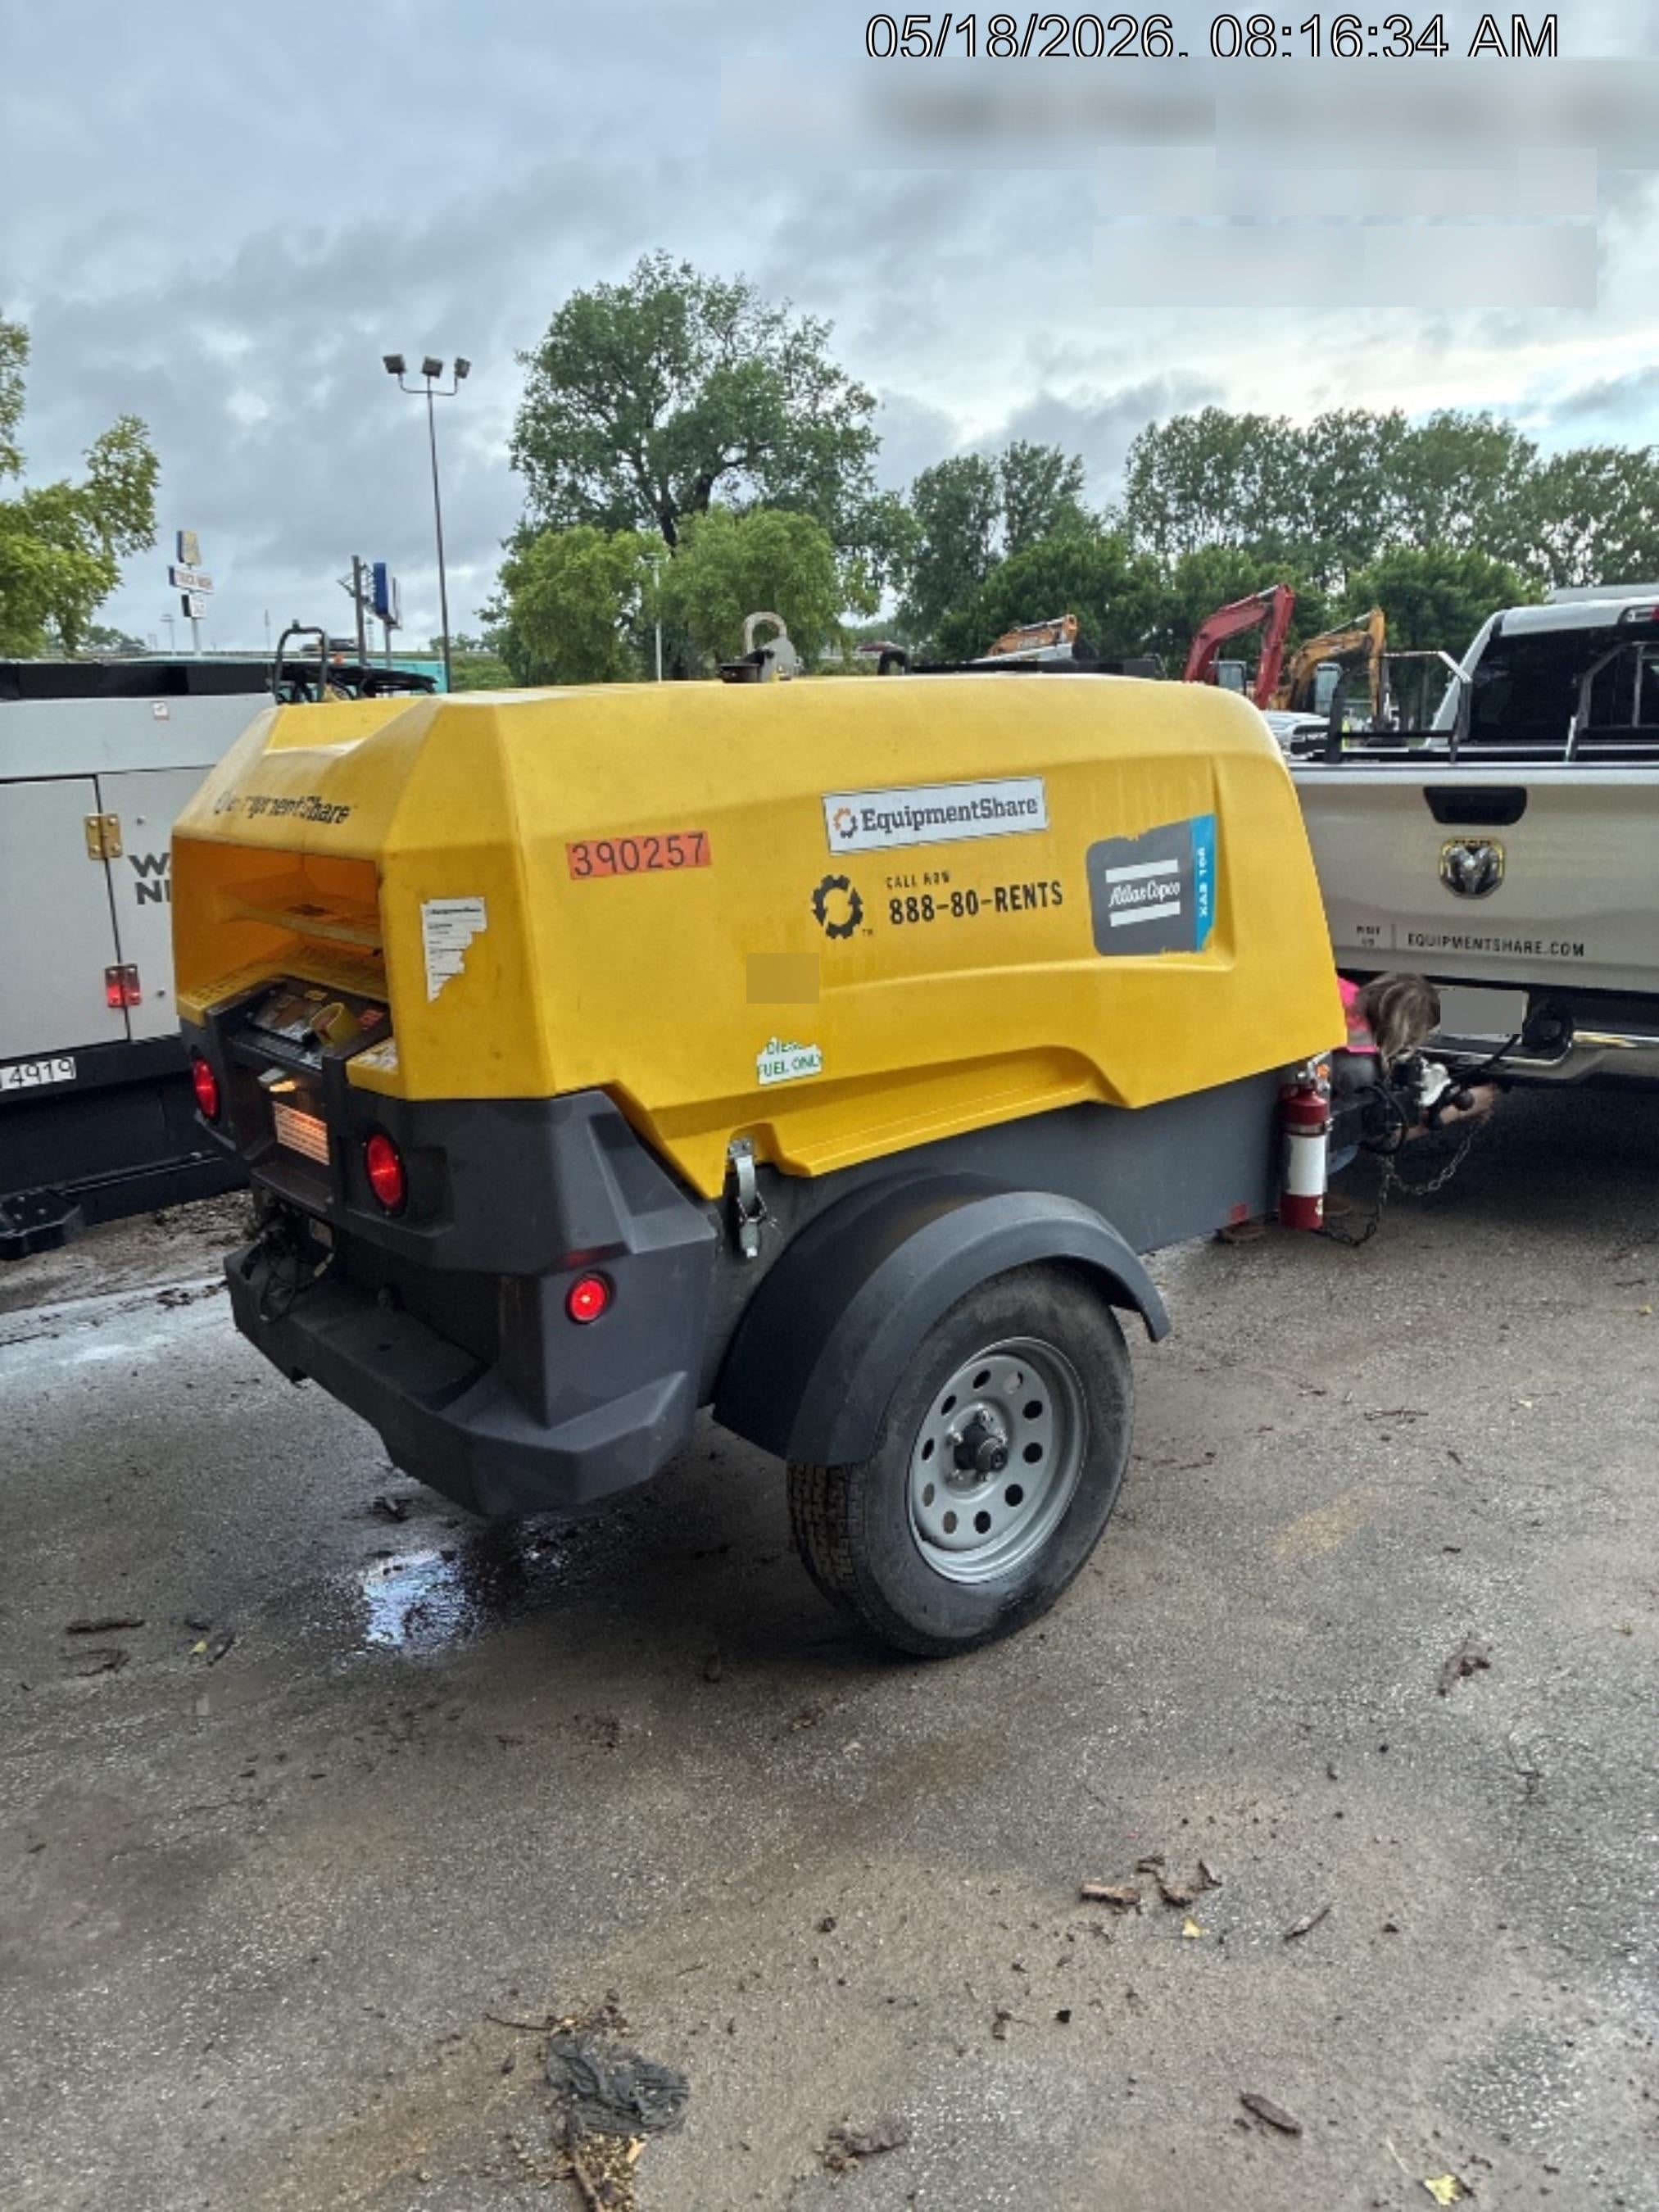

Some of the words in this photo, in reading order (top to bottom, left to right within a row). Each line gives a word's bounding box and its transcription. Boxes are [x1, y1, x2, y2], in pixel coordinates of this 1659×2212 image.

[860, 798, 1039, 834] EquipmentShare
[572, 832, 704, 877] 390257
[886, 874, 918, 890] CALL
[1108, 882, 1146, 907] Atlas
[1147, 879, 1181, 902] Copco
[889, 880, 1063, 926] 888-80-RENTS
[1407, 932, 1585, 957] EQUIPMENTSHARE.COM
